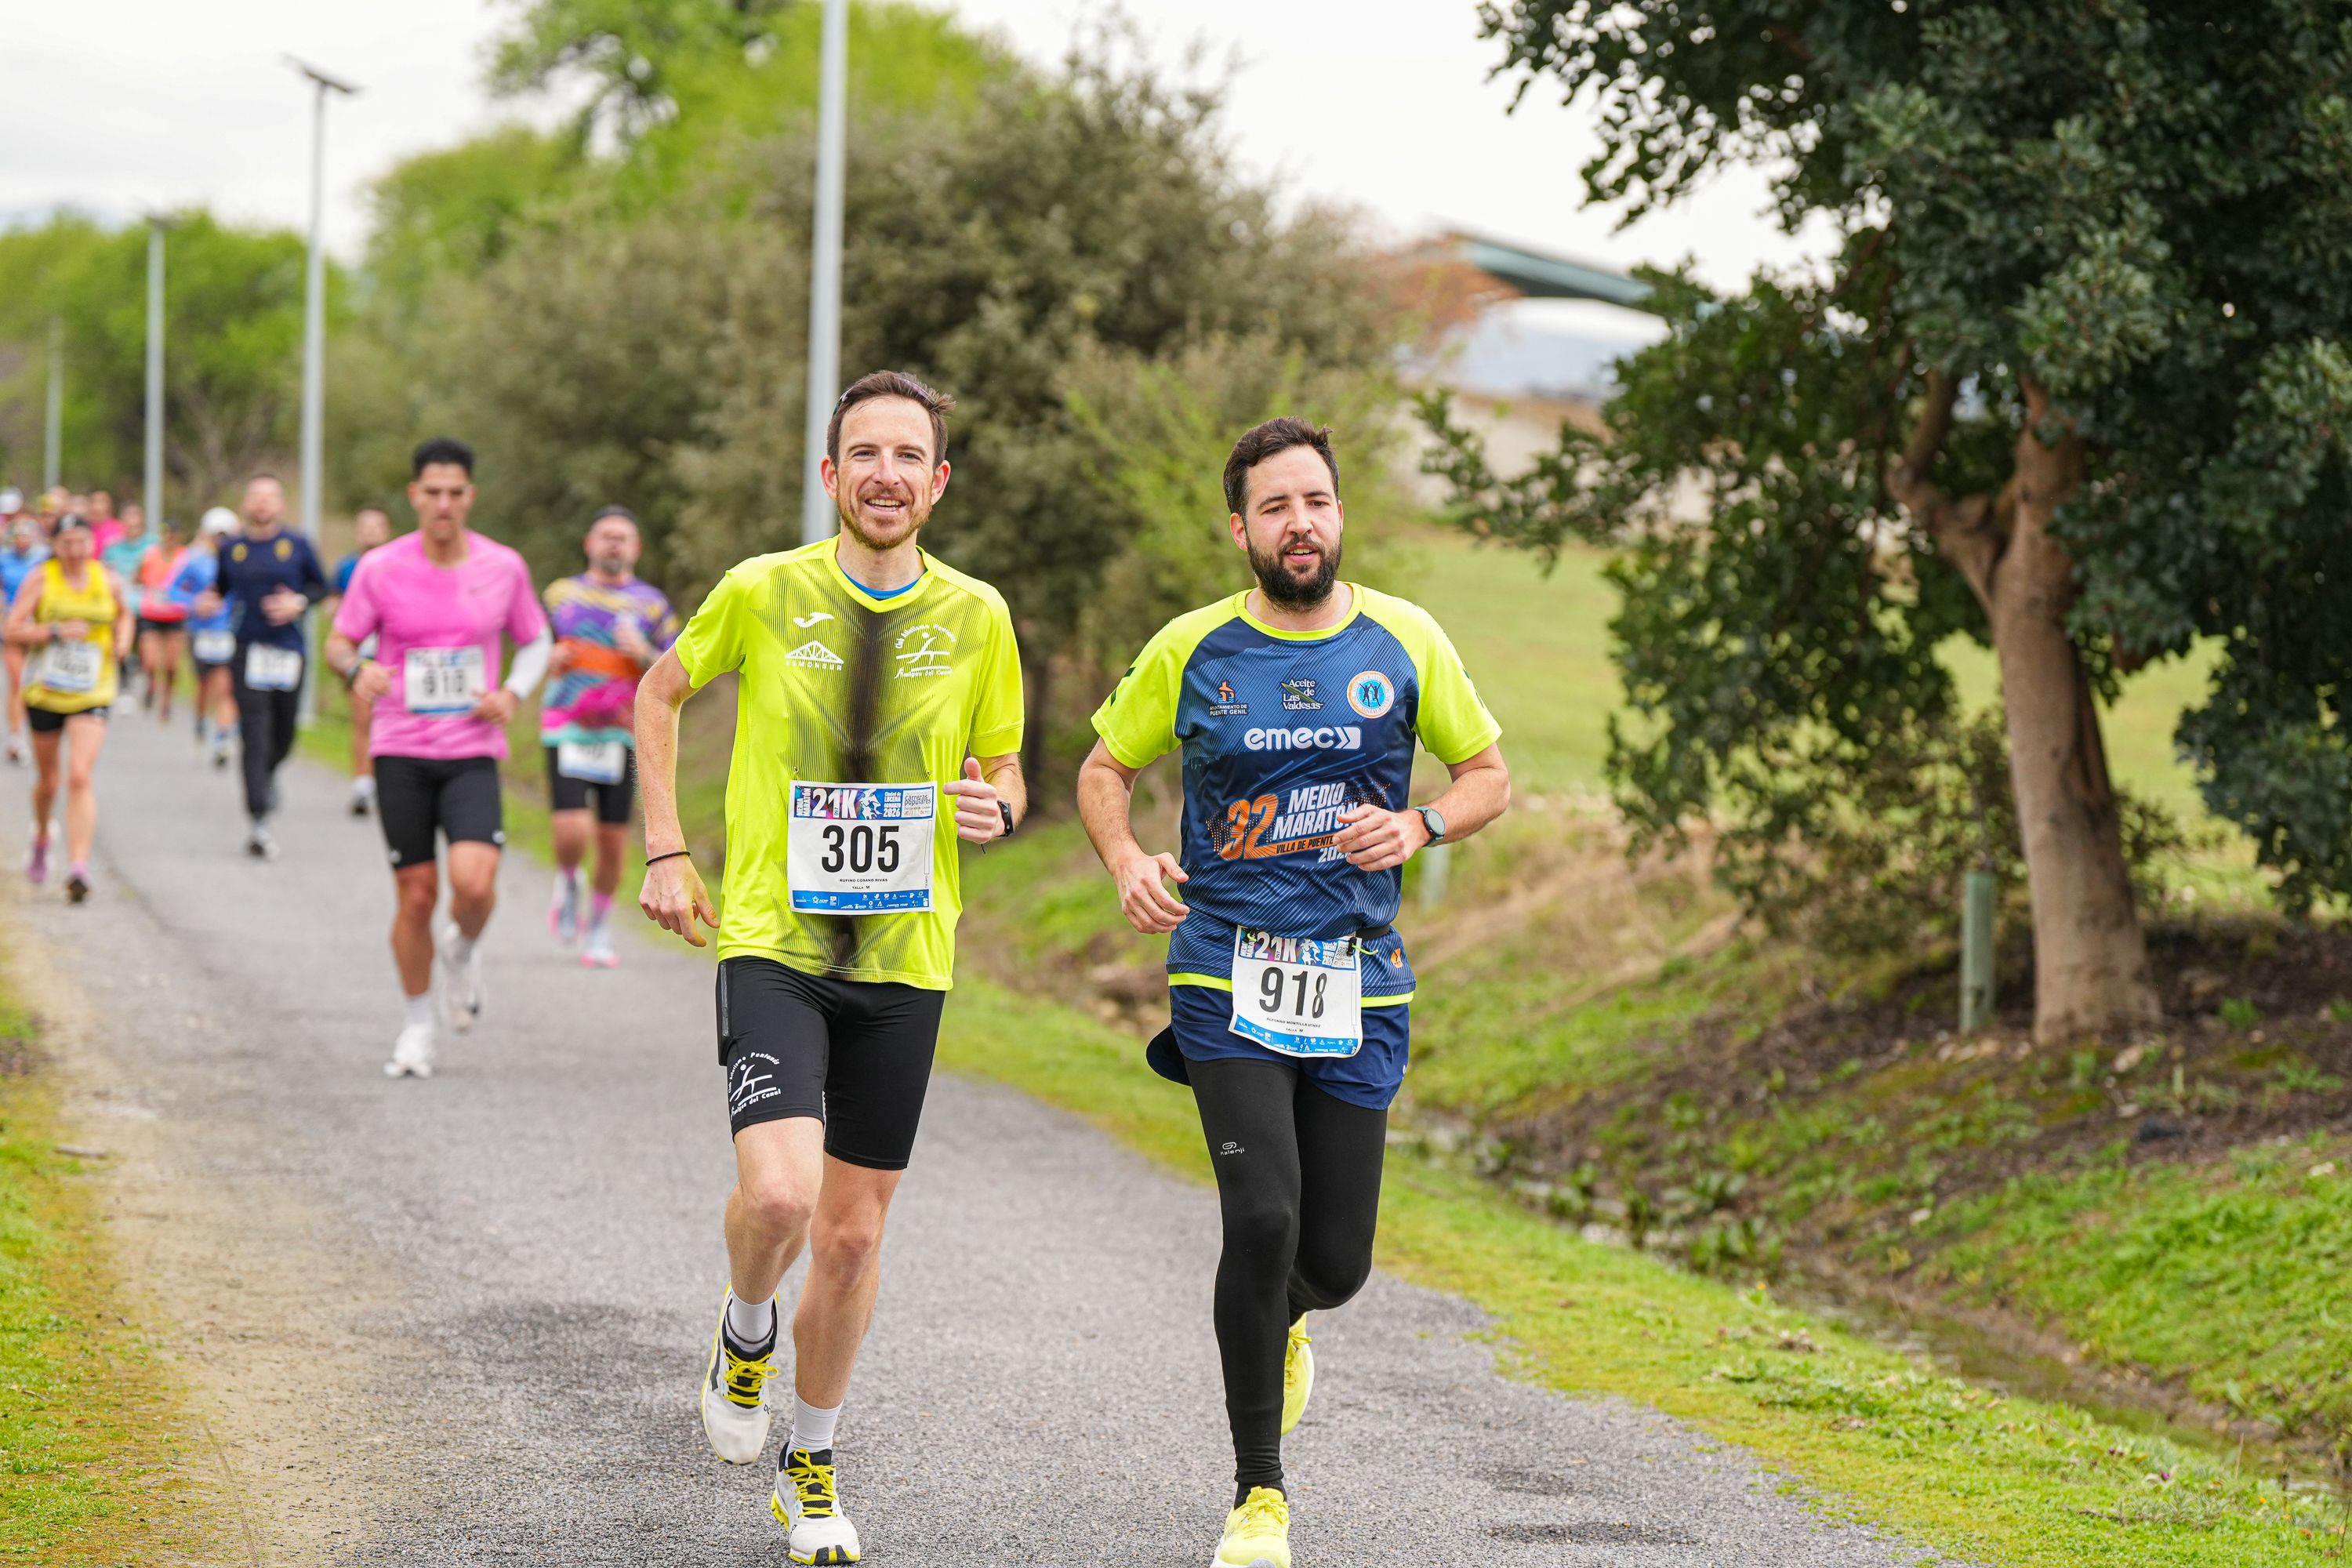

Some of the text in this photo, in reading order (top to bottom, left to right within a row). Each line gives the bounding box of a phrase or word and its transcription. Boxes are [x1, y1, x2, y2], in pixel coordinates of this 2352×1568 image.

[1289, 679, 1316, 688] Aceite
[1283, 701, 1321, 710] Valdesas
[1243, 727, 1334, 750] emec
[812, 788, 858, 818] 21K
[1287, 782, 1345, 814] MEDIO
[884, 808, 901, 817] 2026
[1220, 793, 1279, 861] 32
[822, 825, 899, 873] 305
[1276, 836, 1334, 855] VILLA DE PUENTE
[1259, 967, 1327, 1019] 918
[749, 1096, 759, 1105] del
[762, 1088, 781, 1098] Canal
